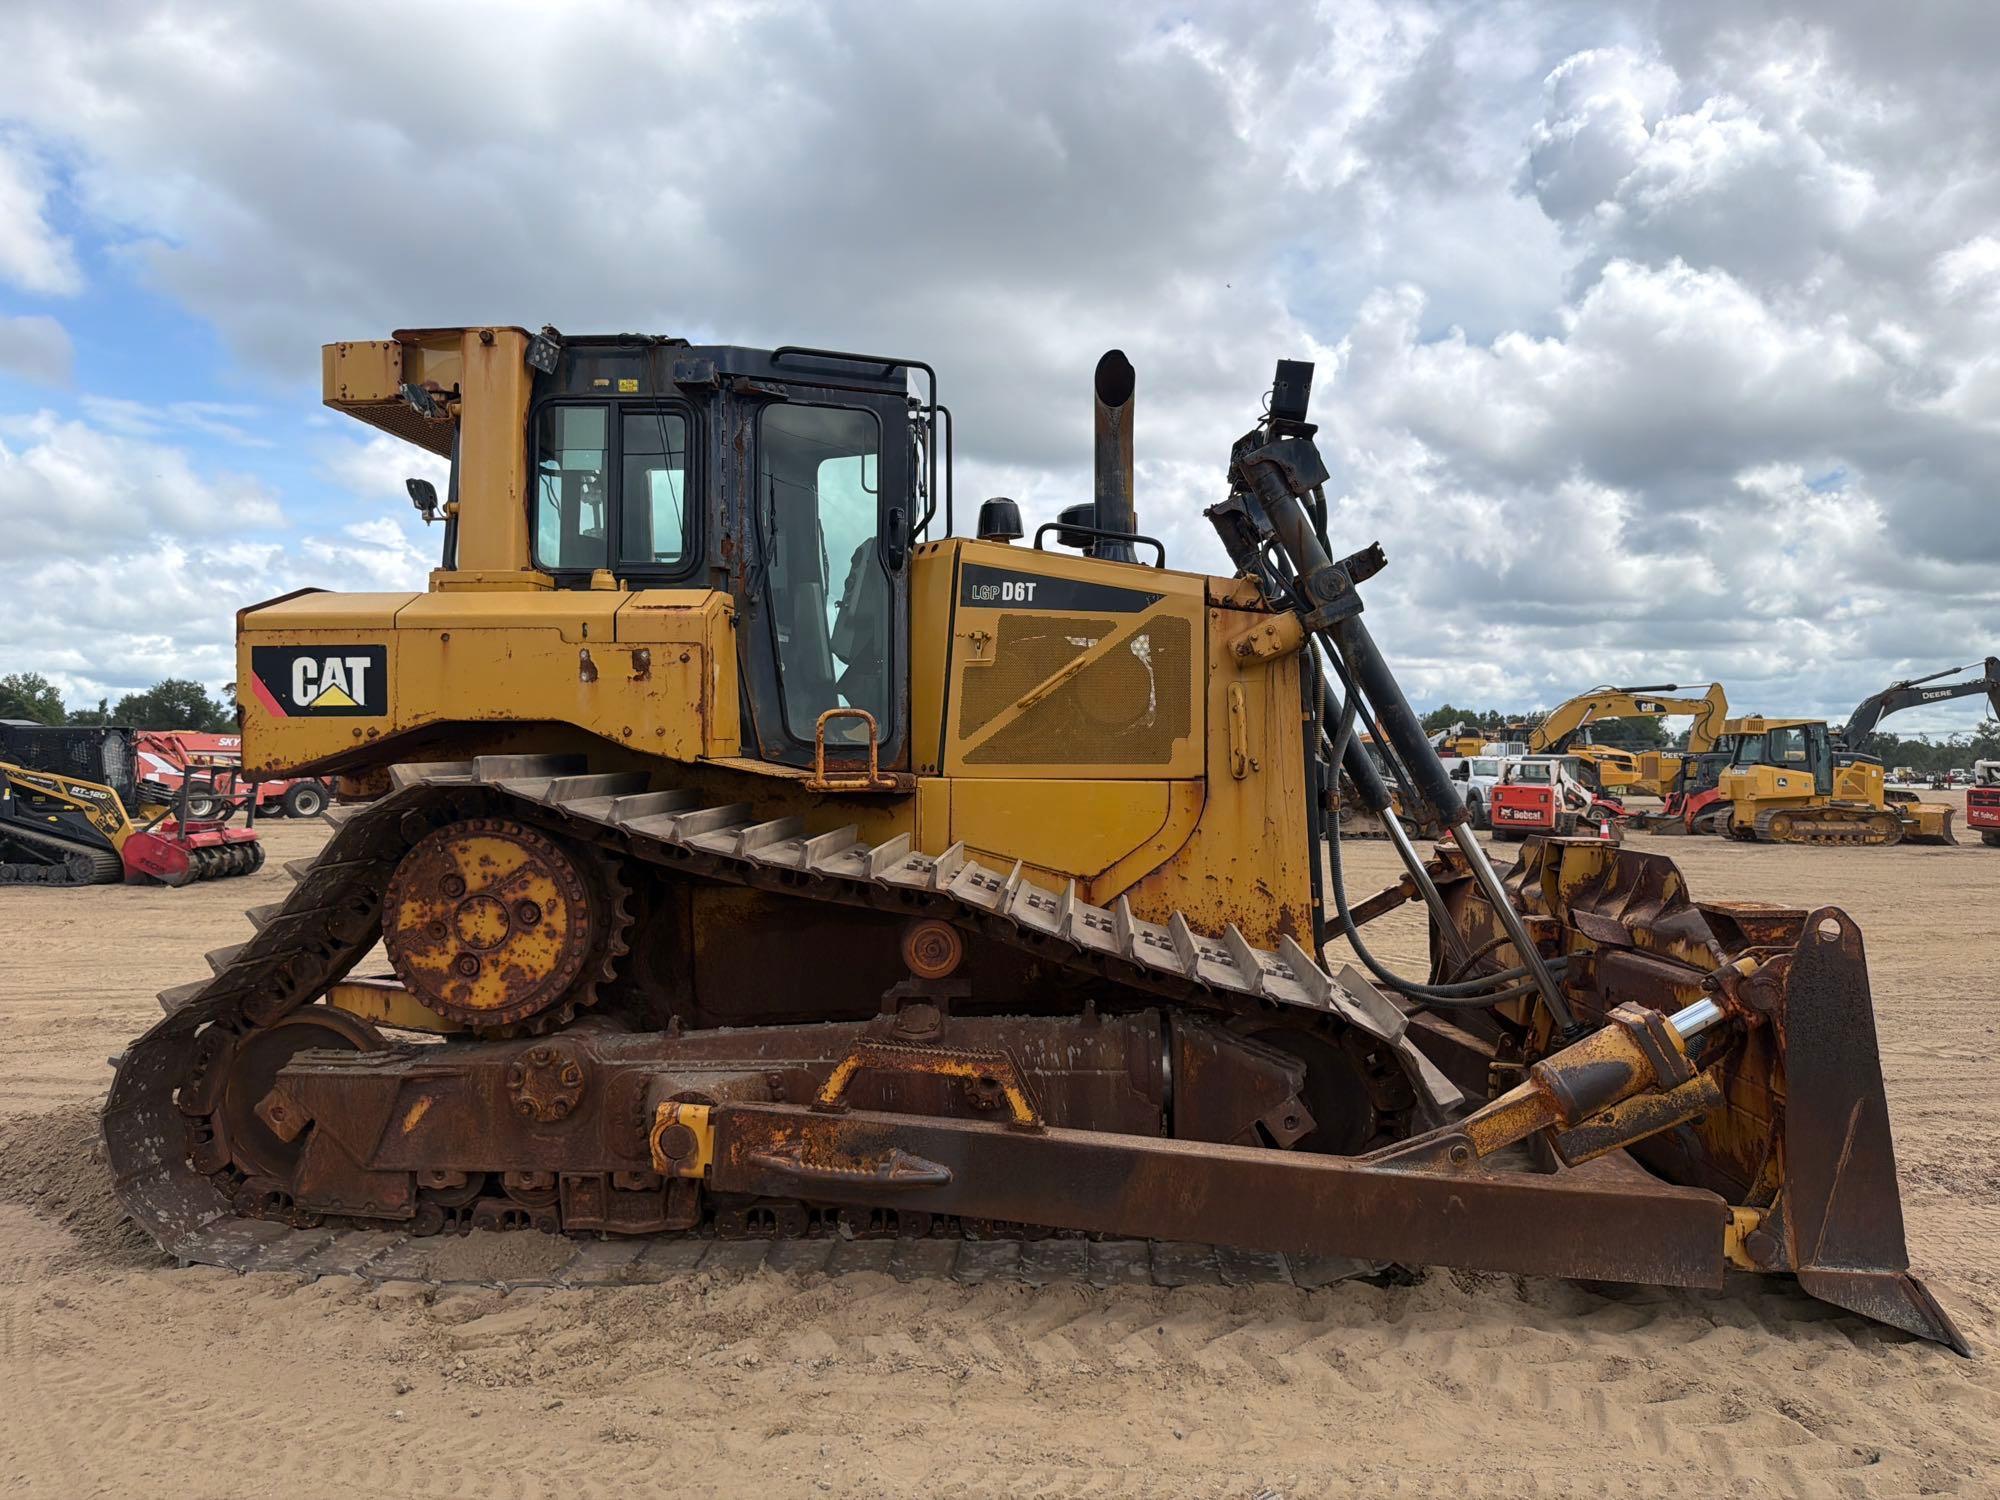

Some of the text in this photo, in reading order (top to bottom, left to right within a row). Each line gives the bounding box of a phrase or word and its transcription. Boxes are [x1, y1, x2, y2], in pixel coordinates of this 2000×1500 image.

[972, 581, 1037, 601] LGP D6T
[293, 656, 371, 706] CAT
[1922, 690, 1953, 699] DEERE
[1641, 703, 1656, 712] CAT
[70, 786, 108, 799] RT-120
[1513, 810, 1541, 820] Bobcat
